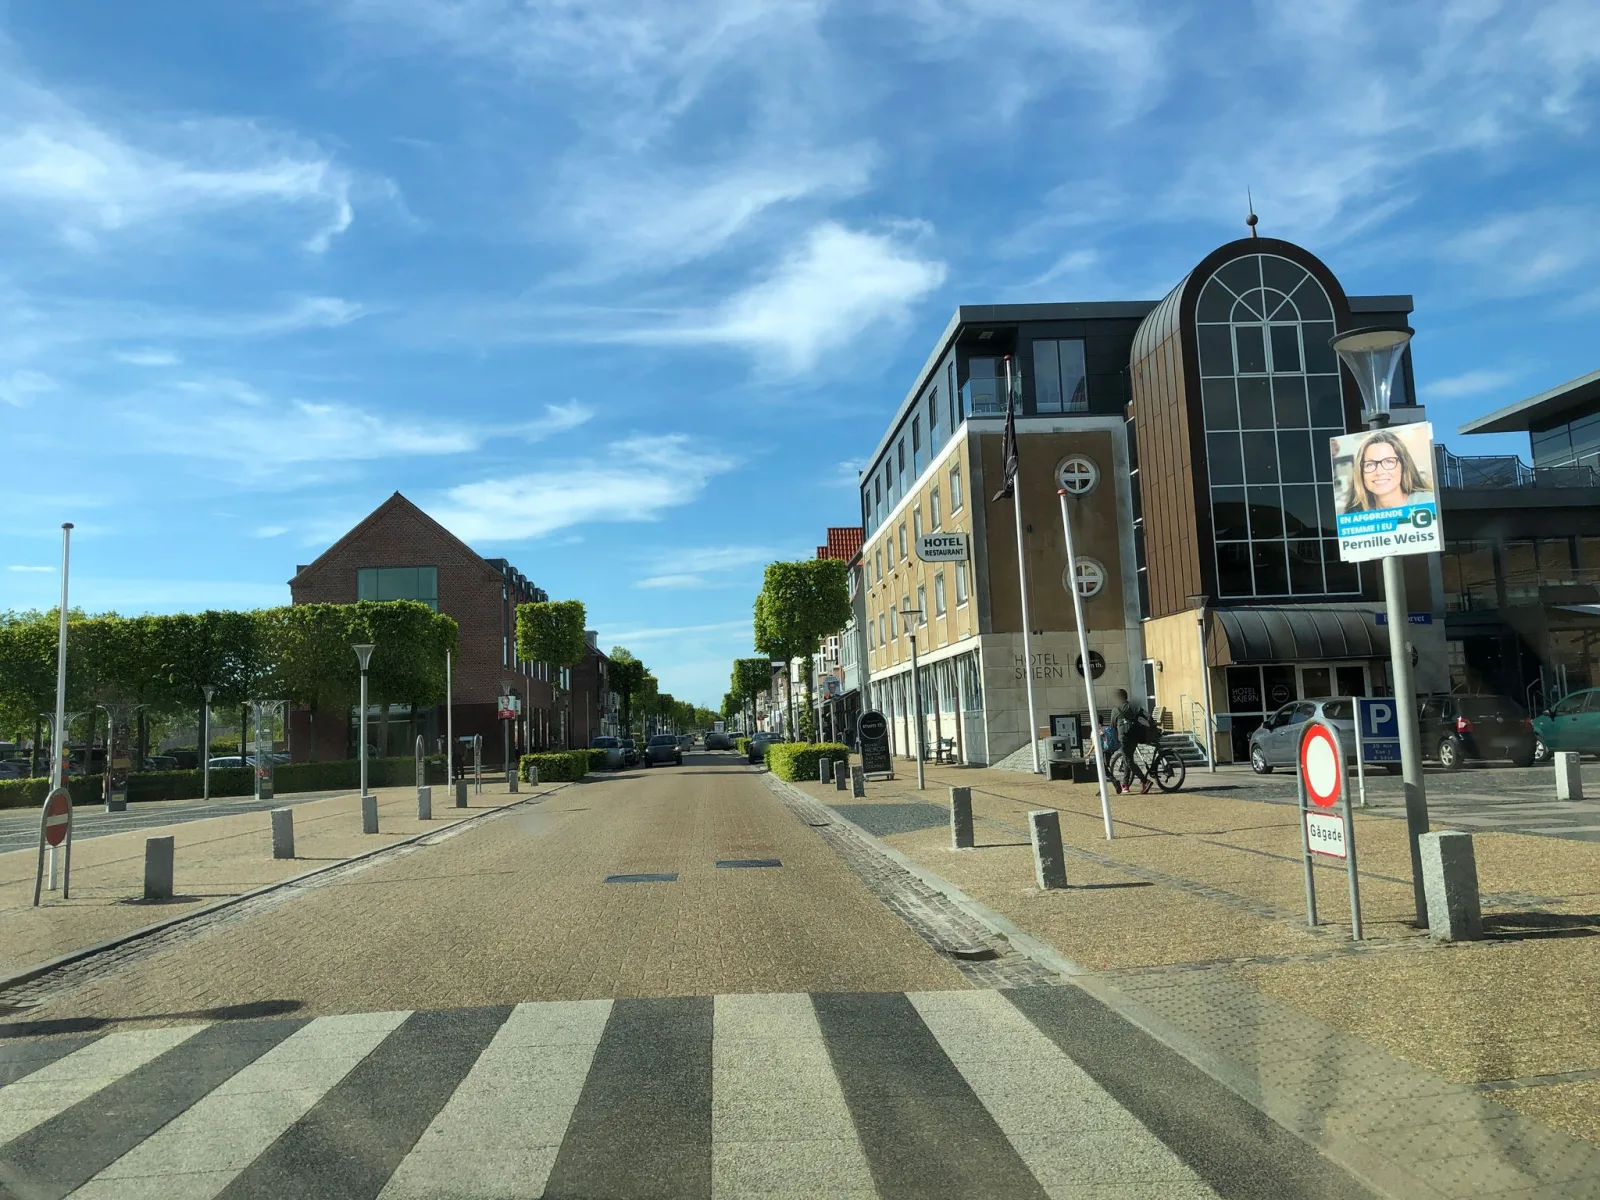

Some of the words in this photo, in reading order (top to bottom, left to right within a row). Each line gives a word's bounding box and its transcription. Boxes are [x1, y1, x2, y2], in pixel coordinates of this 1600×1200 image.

[1340, 515, 1351, 525] EN
[1352, 510, 1404, 523] AFGØRENDE
[1341, 524, 1375, 536] STEMME
[1381, 522, 1393, 531] EU
[924, 537, 963, 548] HOTEL
[1342, 536, 1391, 550] Pernille
[1395, 532, 1435, 544] Weiss
[924, 548, 964, 557] RESTAURANT
[1231, 687, 1257, 695] HOTEL
[1232, 694, 1259, 703] SKJERN
[1369, 703, 1392, 734] P
[1310, 824, 1342, 842] Gågade
